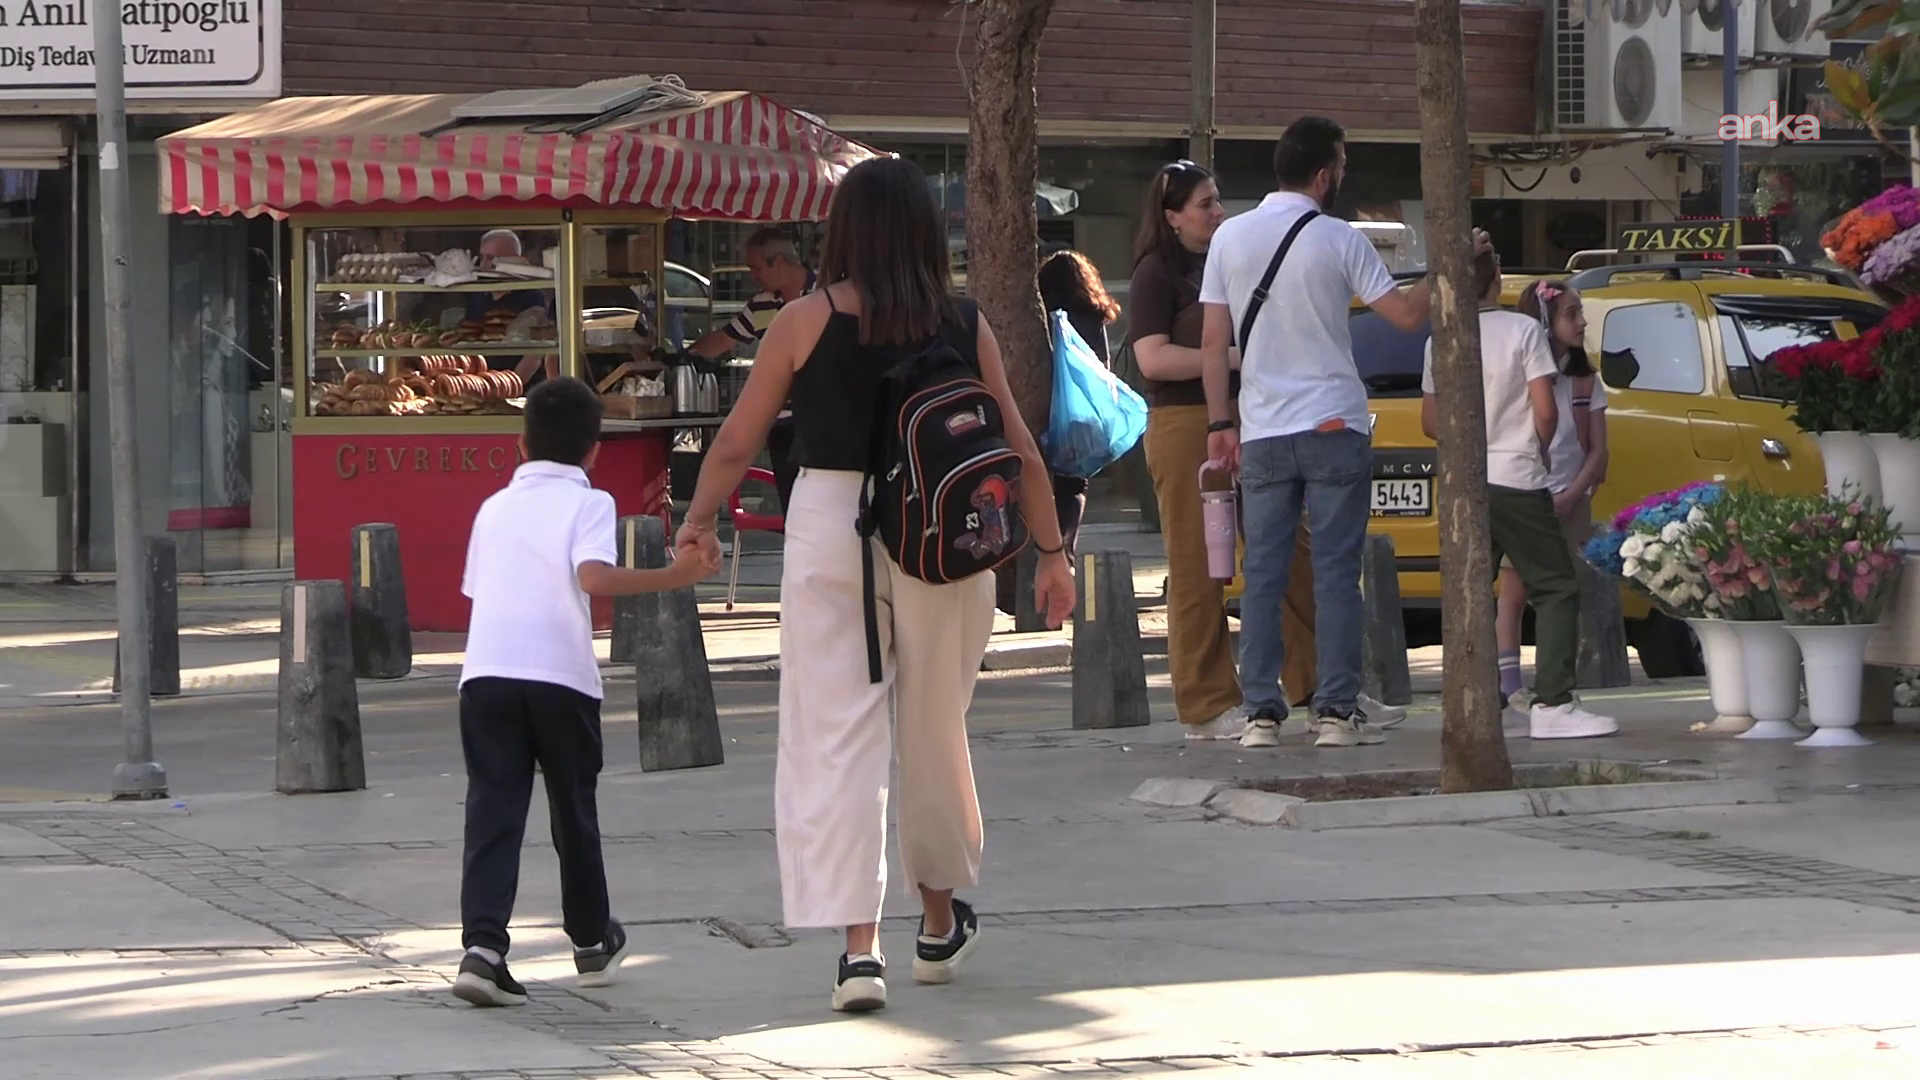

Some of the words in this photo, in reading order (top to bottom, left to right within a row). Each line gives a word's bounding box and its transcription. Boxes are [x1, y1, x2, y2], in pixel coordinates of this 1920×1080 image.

[0, 46, 35, 71] Diş
[39, 45, 127, 66] Tedavi
[131, 45, 215, 65] Uzmanı
[1622, 222, 1732, 250] TAKSİ
[1377, 483, 1422, 506] 5443
[965, 511, 980, 529] 23
